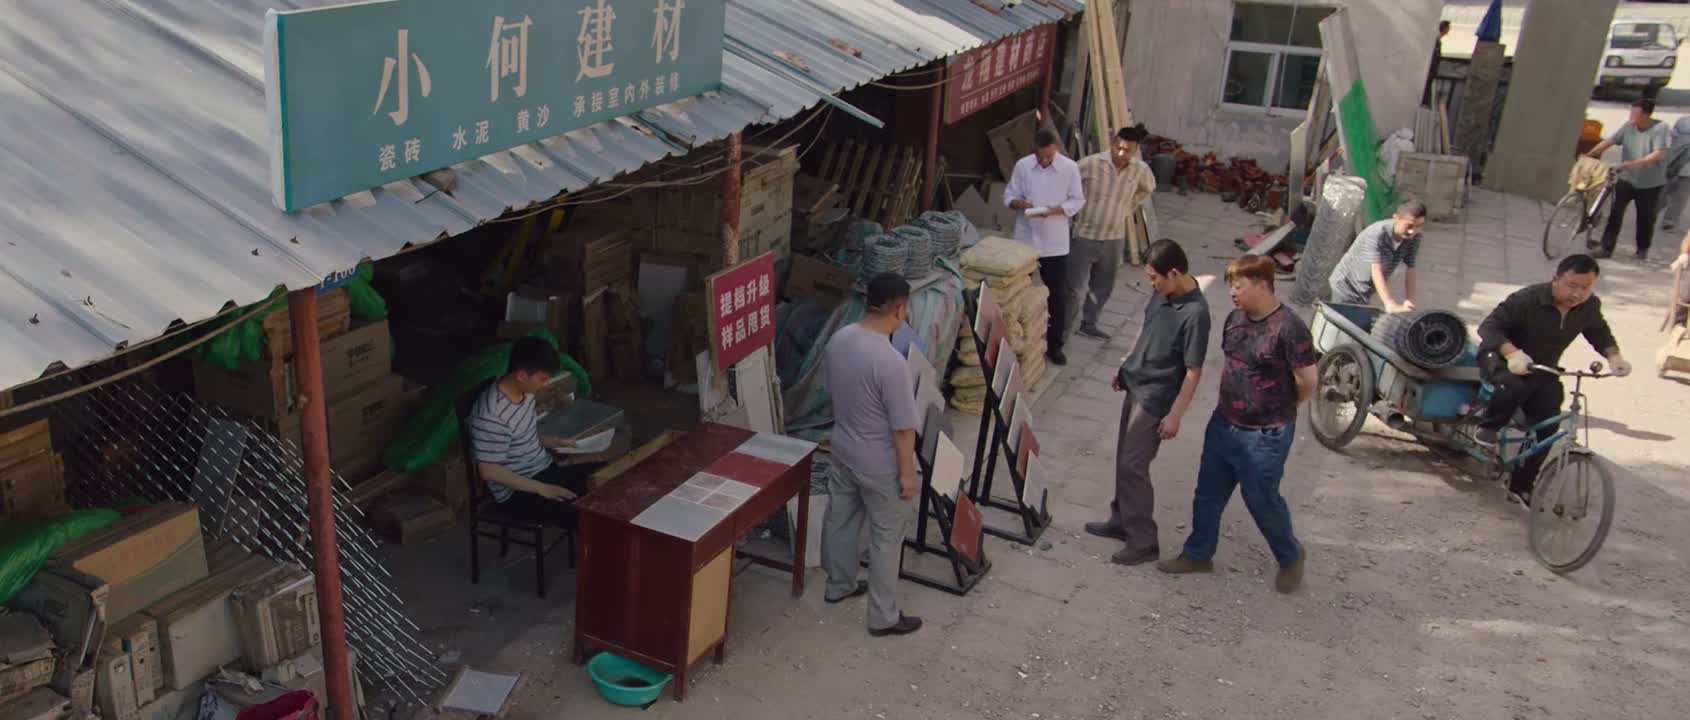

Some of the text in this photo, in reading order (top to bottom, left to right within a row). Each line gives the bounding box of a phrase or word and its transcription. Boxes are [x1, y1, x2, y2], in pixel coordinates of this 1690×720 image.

[374, 0, 686, 126] 小何建材
[378, 71, 680, 172] 瓷砖 水泥 黄沙 承接室内外装修
[720, 274, 770, 318] 提档升级
[721, 304, 771, 351] 样品甩货
